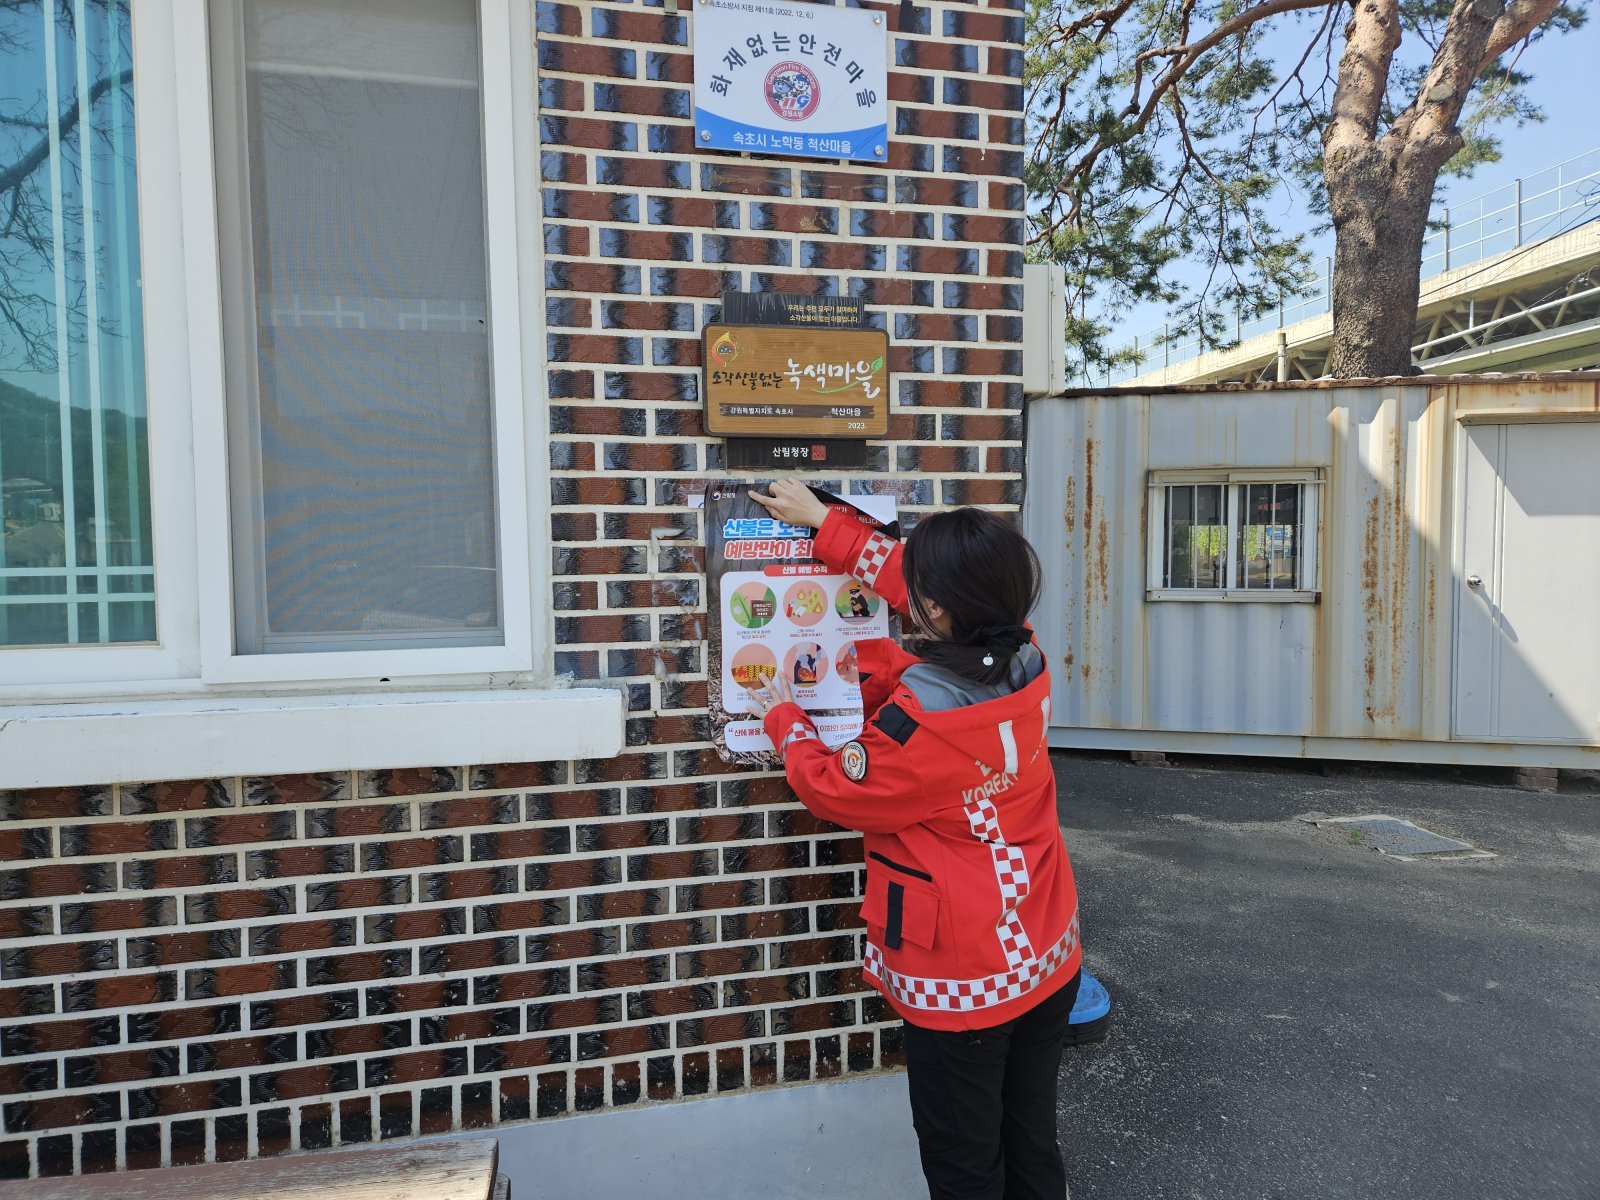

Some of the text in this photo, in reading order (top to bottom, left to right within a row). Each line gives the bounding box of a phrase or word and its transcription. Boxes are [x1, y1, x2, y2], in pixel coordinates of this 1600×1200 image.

[709, 0, 740, 11] 속초소방서
[741, 4, 754, 13] 지정
[754, 6, 775, 15] 제11호
[788, 63, 800, 71] Fire
[733, 131, 851, 154] 속초시 노학동 척산마을
[788, 304, 805, 313] 우리는
[818, 305, 835, 313] 모두가
[789, 314, 818, 323] 소각산불이
[818, 315, 830, 323] 없는
[783, 358, 881, 399] 녹색마을
[730, 406, 862, 417] 강원특별자치도 속초시 척산마을
[772, 446, 809, 458] 산림청장
[723, 518, 774, 538] 산불은
[724, 540, 791, 560] 예방만이
[782, 565, 828, 575] 산불 예방 수칙
[819, 724, 839, 733] 이하의
[961, 771, 1015, 805] KOREA
